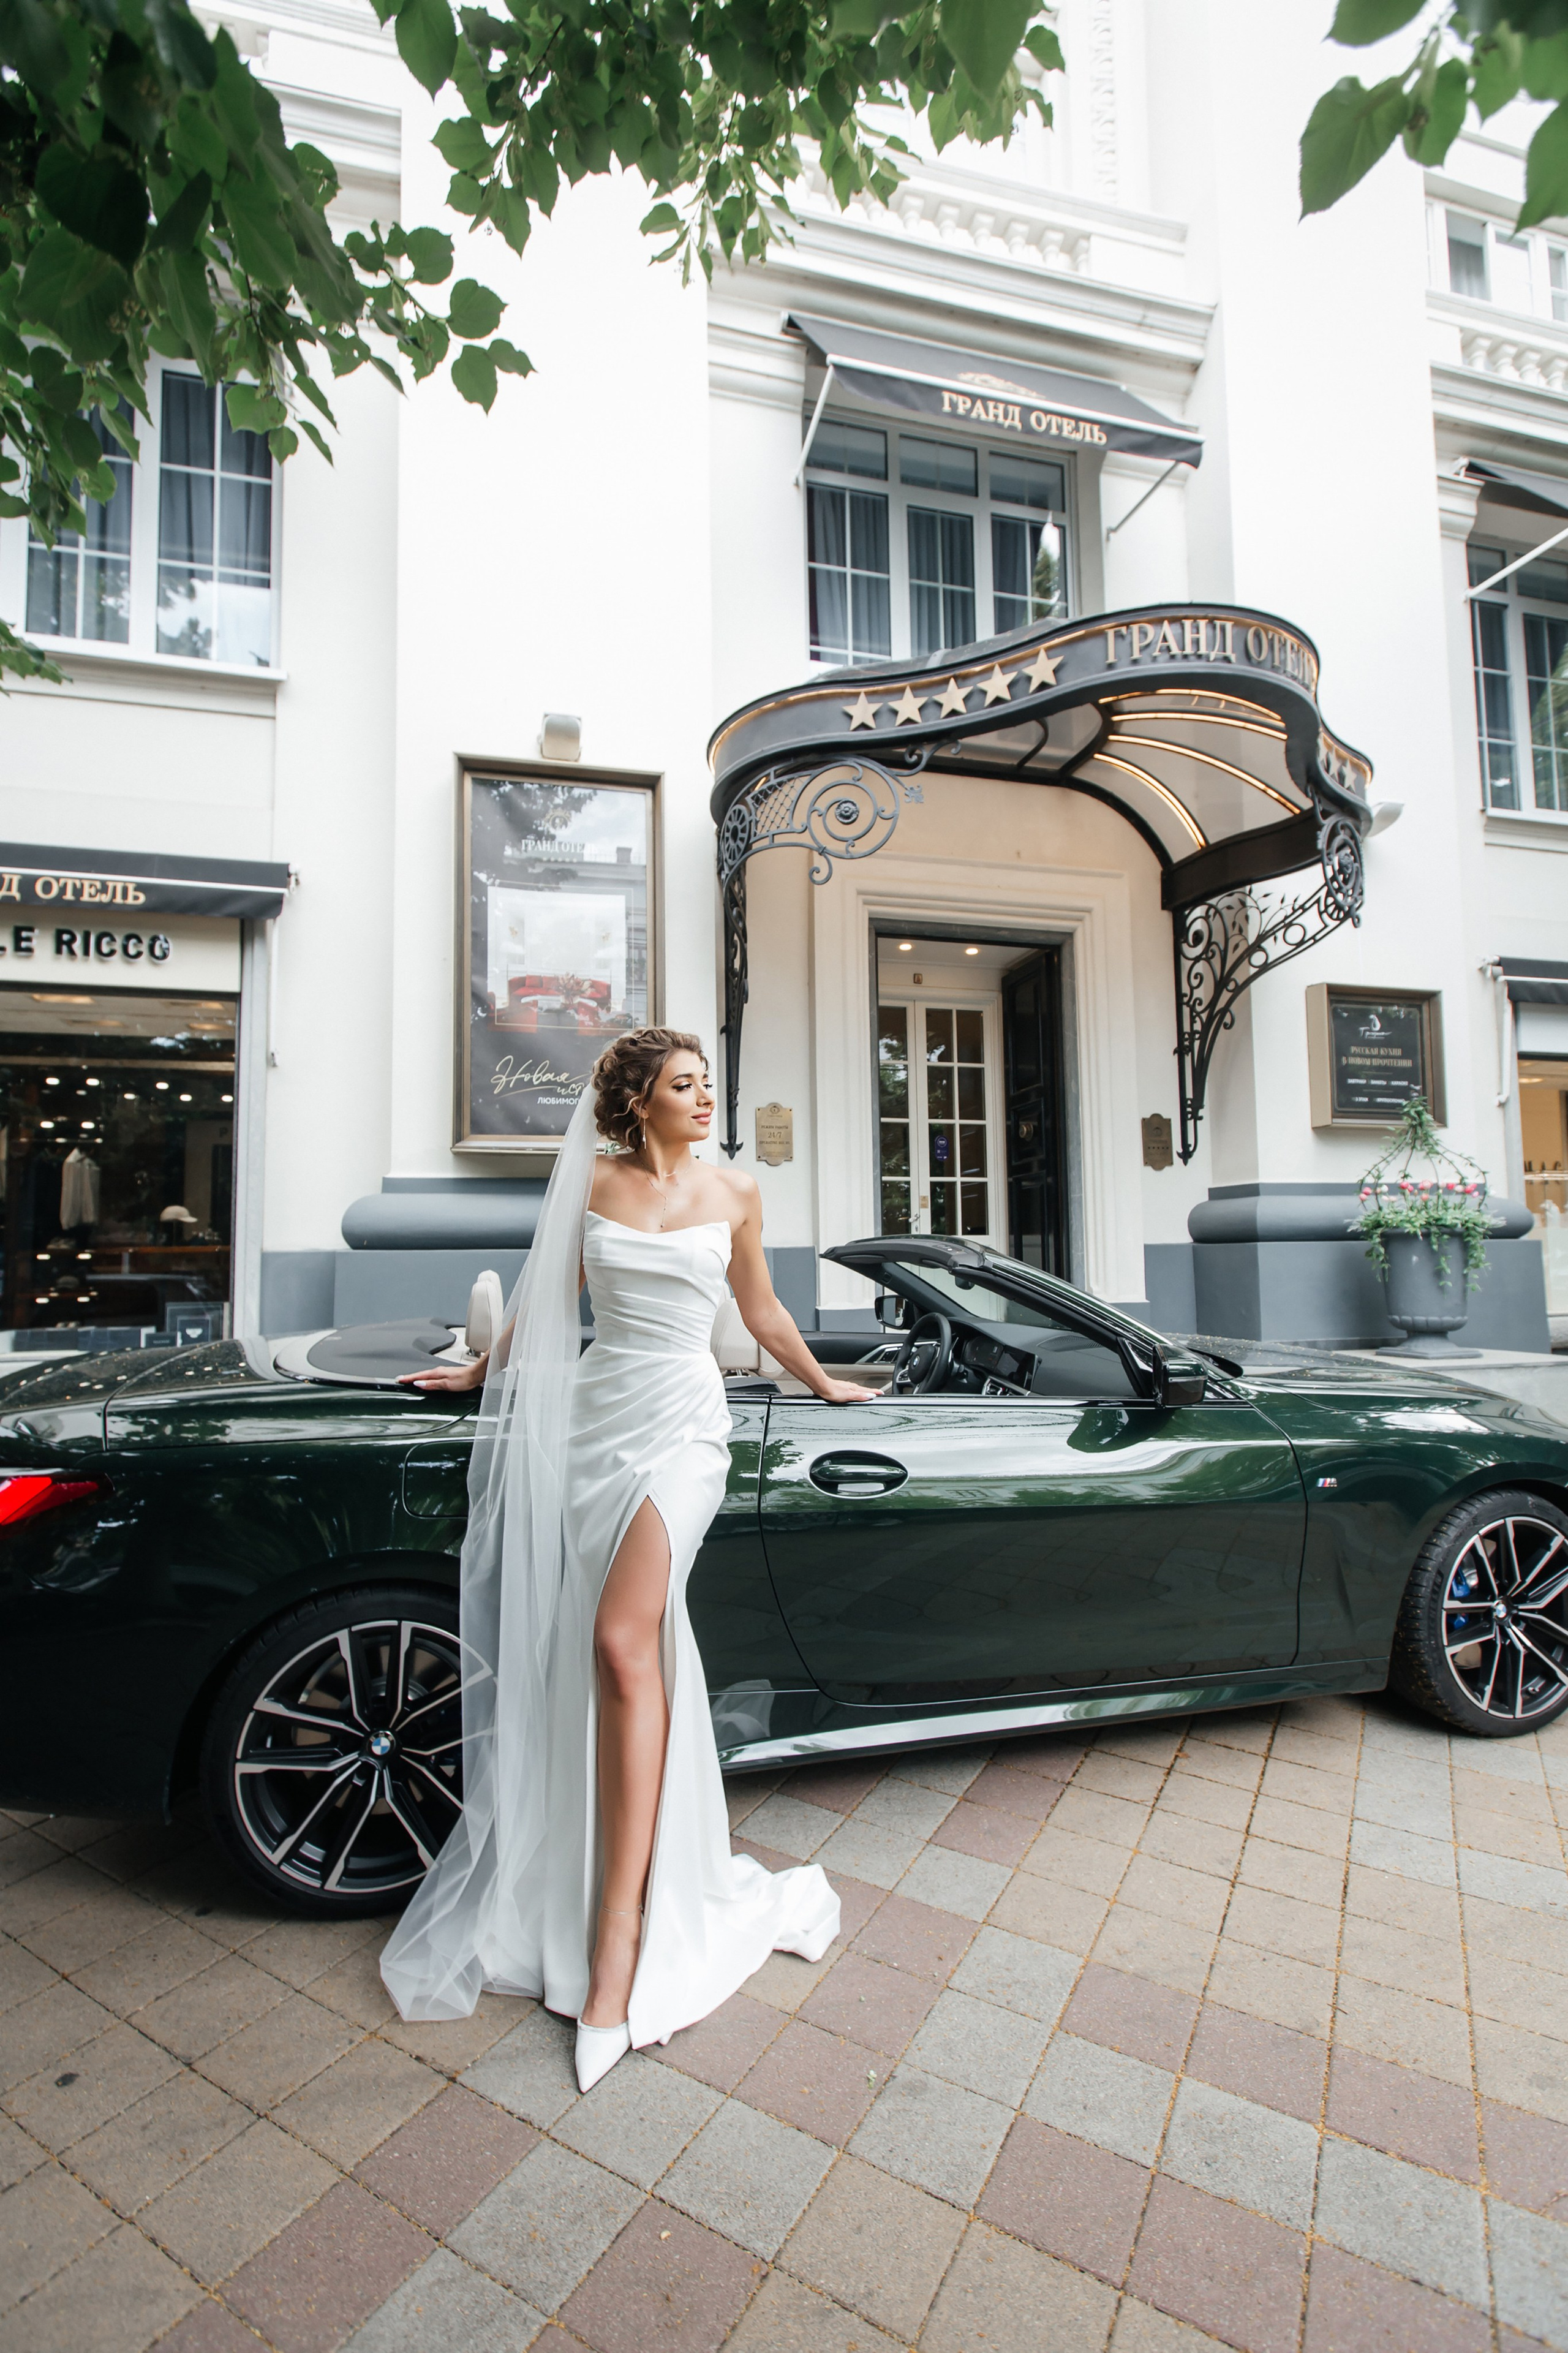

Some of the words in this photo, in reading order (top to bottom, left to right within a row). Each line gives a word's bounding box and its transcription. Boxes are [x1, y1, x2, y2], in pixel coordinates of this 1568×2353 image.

[941, 391, 1023, 432] ГРАНД
[1030, 410, 1107, 446] ОТЕЛЬ
[1105, 619, 1236, 664] ГРАНД
[521, 839, 559, 853] ГРАНД
[34, 876, 146, 905] ОТЕЛЬ
[55, 928, 170, 961] RICCO
[490, 1055, 591, 1095] Новая
